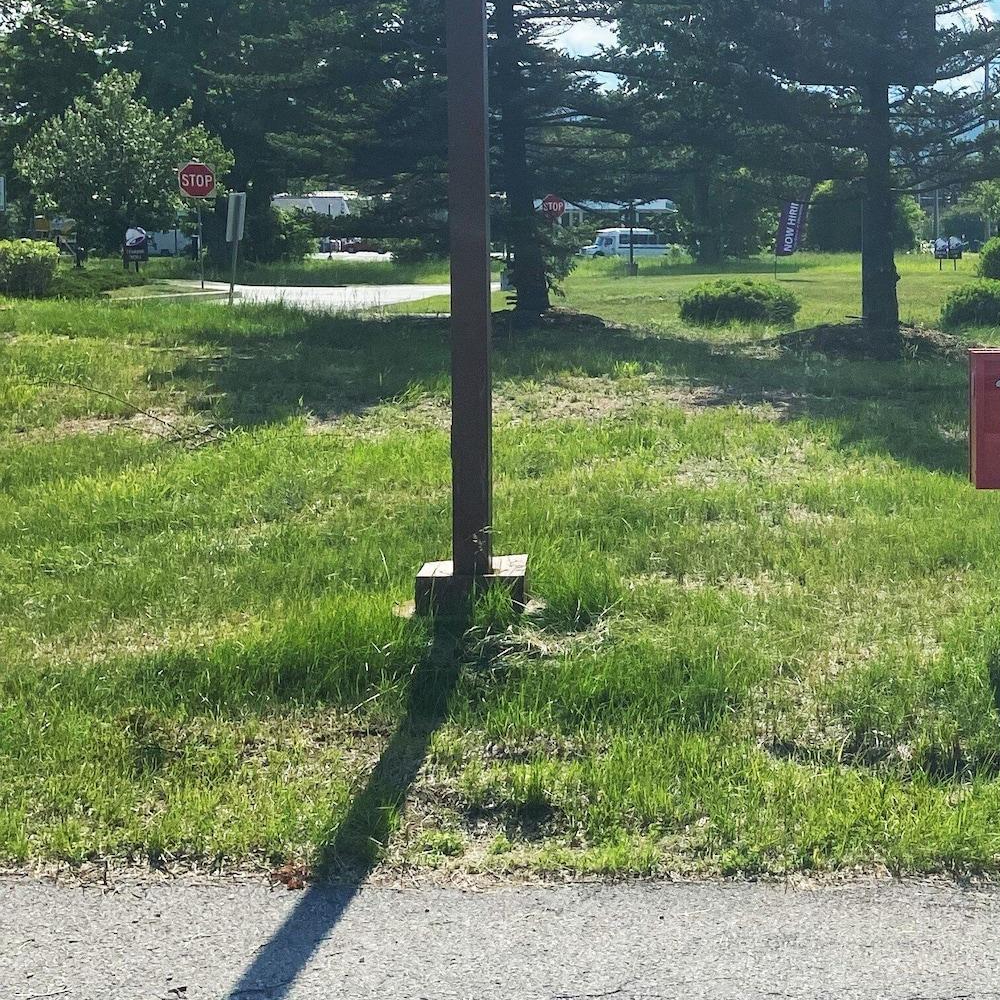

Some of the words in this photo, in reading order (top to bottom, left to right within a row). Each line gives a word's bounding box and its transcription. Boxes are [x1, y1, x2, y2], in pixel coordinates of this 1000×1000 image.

[181, 173, 213, 188] STOP
[543, 201, 564, 212] STOP
[783, 227, 795, 252] NOW
